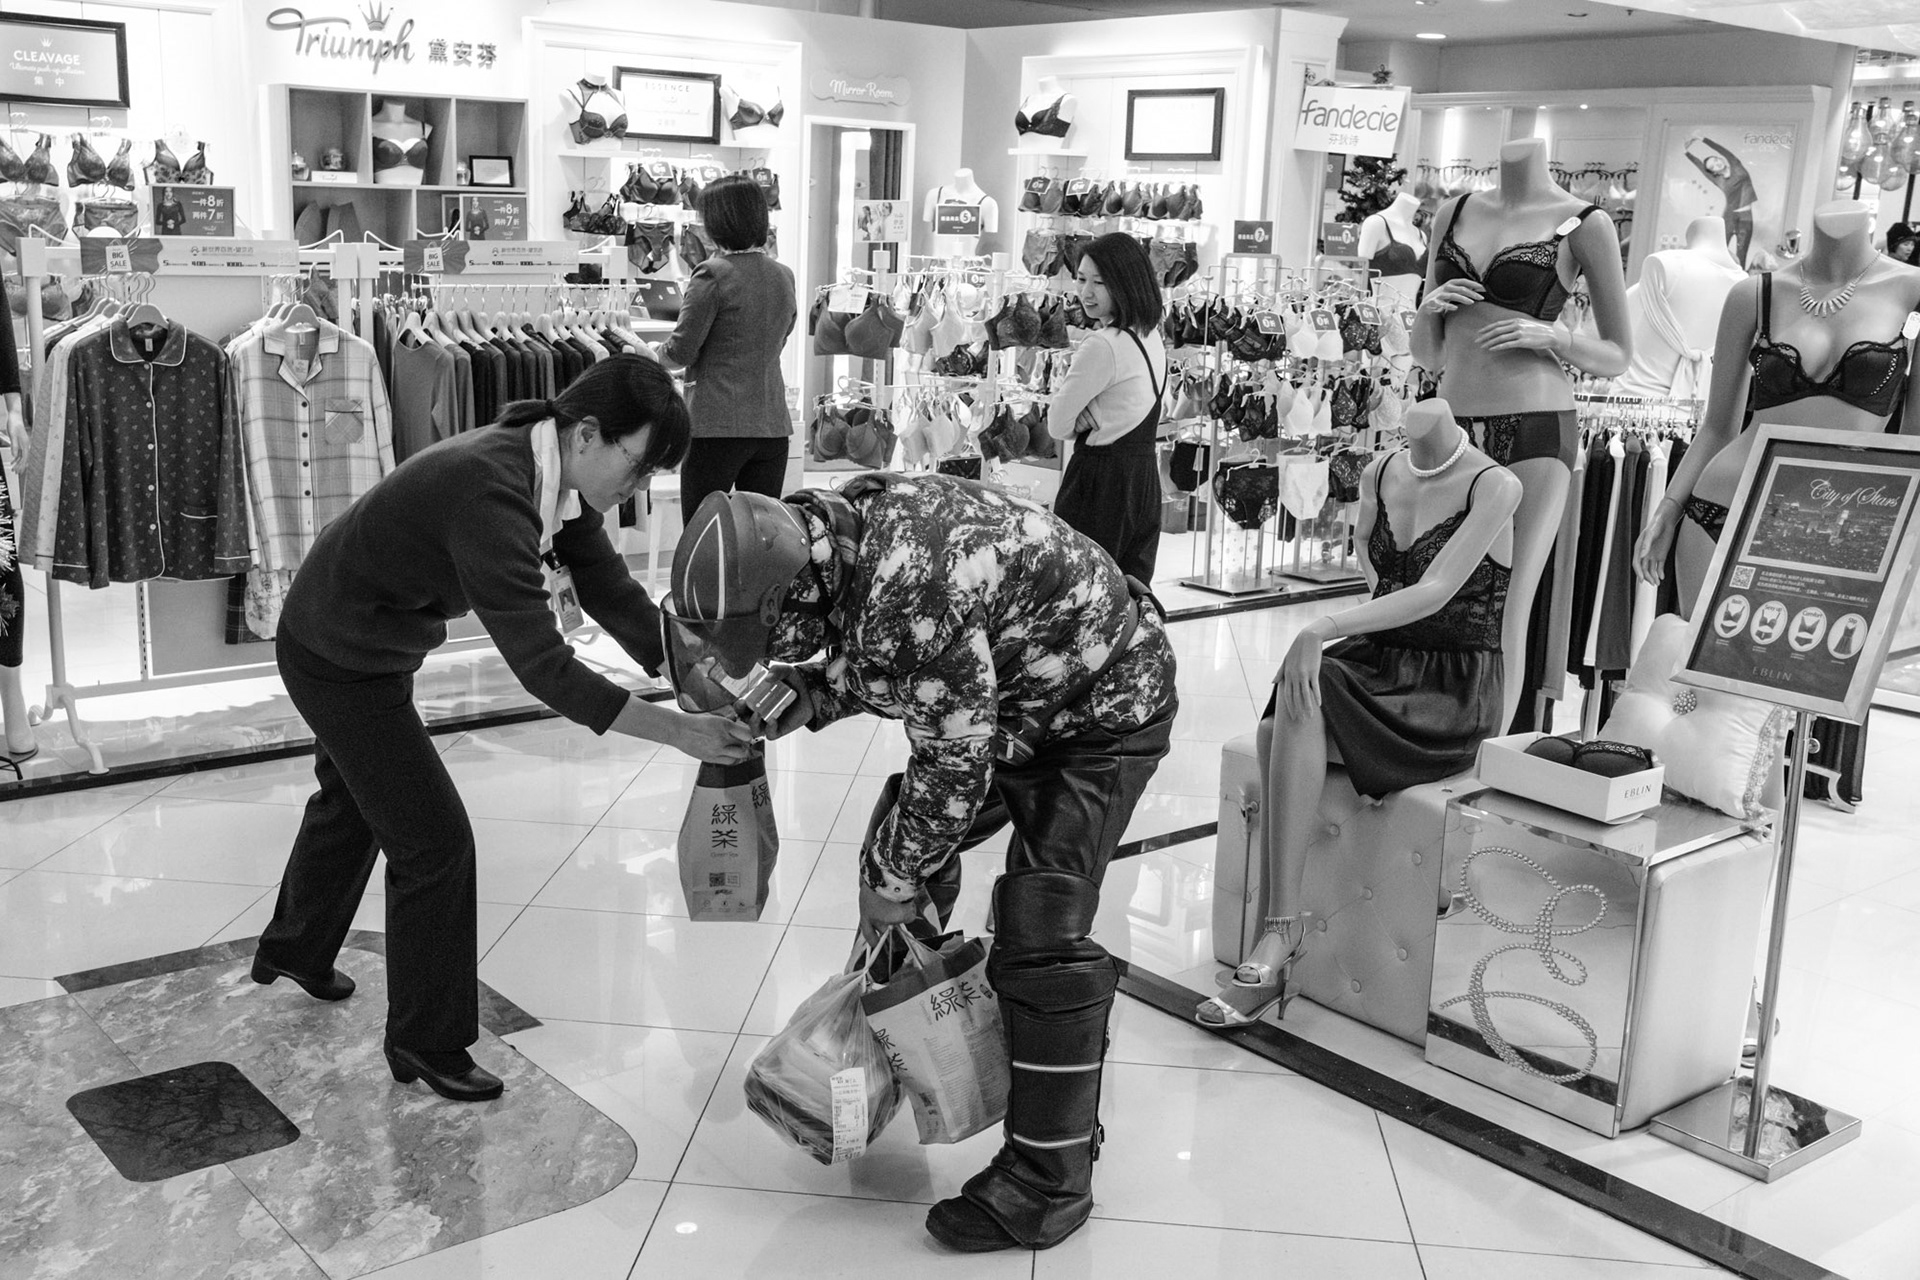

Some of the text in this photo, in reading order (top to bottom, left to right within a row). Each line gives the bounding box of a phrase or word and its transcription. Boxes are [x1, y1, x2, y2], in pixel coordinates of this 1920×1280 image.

[265, 7, 415, 74] Triumph
[13, 49, 81, 66] CLEAVAGE
[428, 39, 498, 69] 黛安芬
[829, 79, 895, 99] Mirror Room
[111, 251, 124, 259] BIG
[428, 253, 439, 261] BIG
[109, 260, 127, 268] SALE
[426, 260, 441, 268] SALE
[1810, 478, 1900, 509] City of Stars
[1802, 610, 1823, 618] Comfort
[1752, 666, 1792, 682] EBLIN
[1624, 784, 1652, 799] EBLIN
